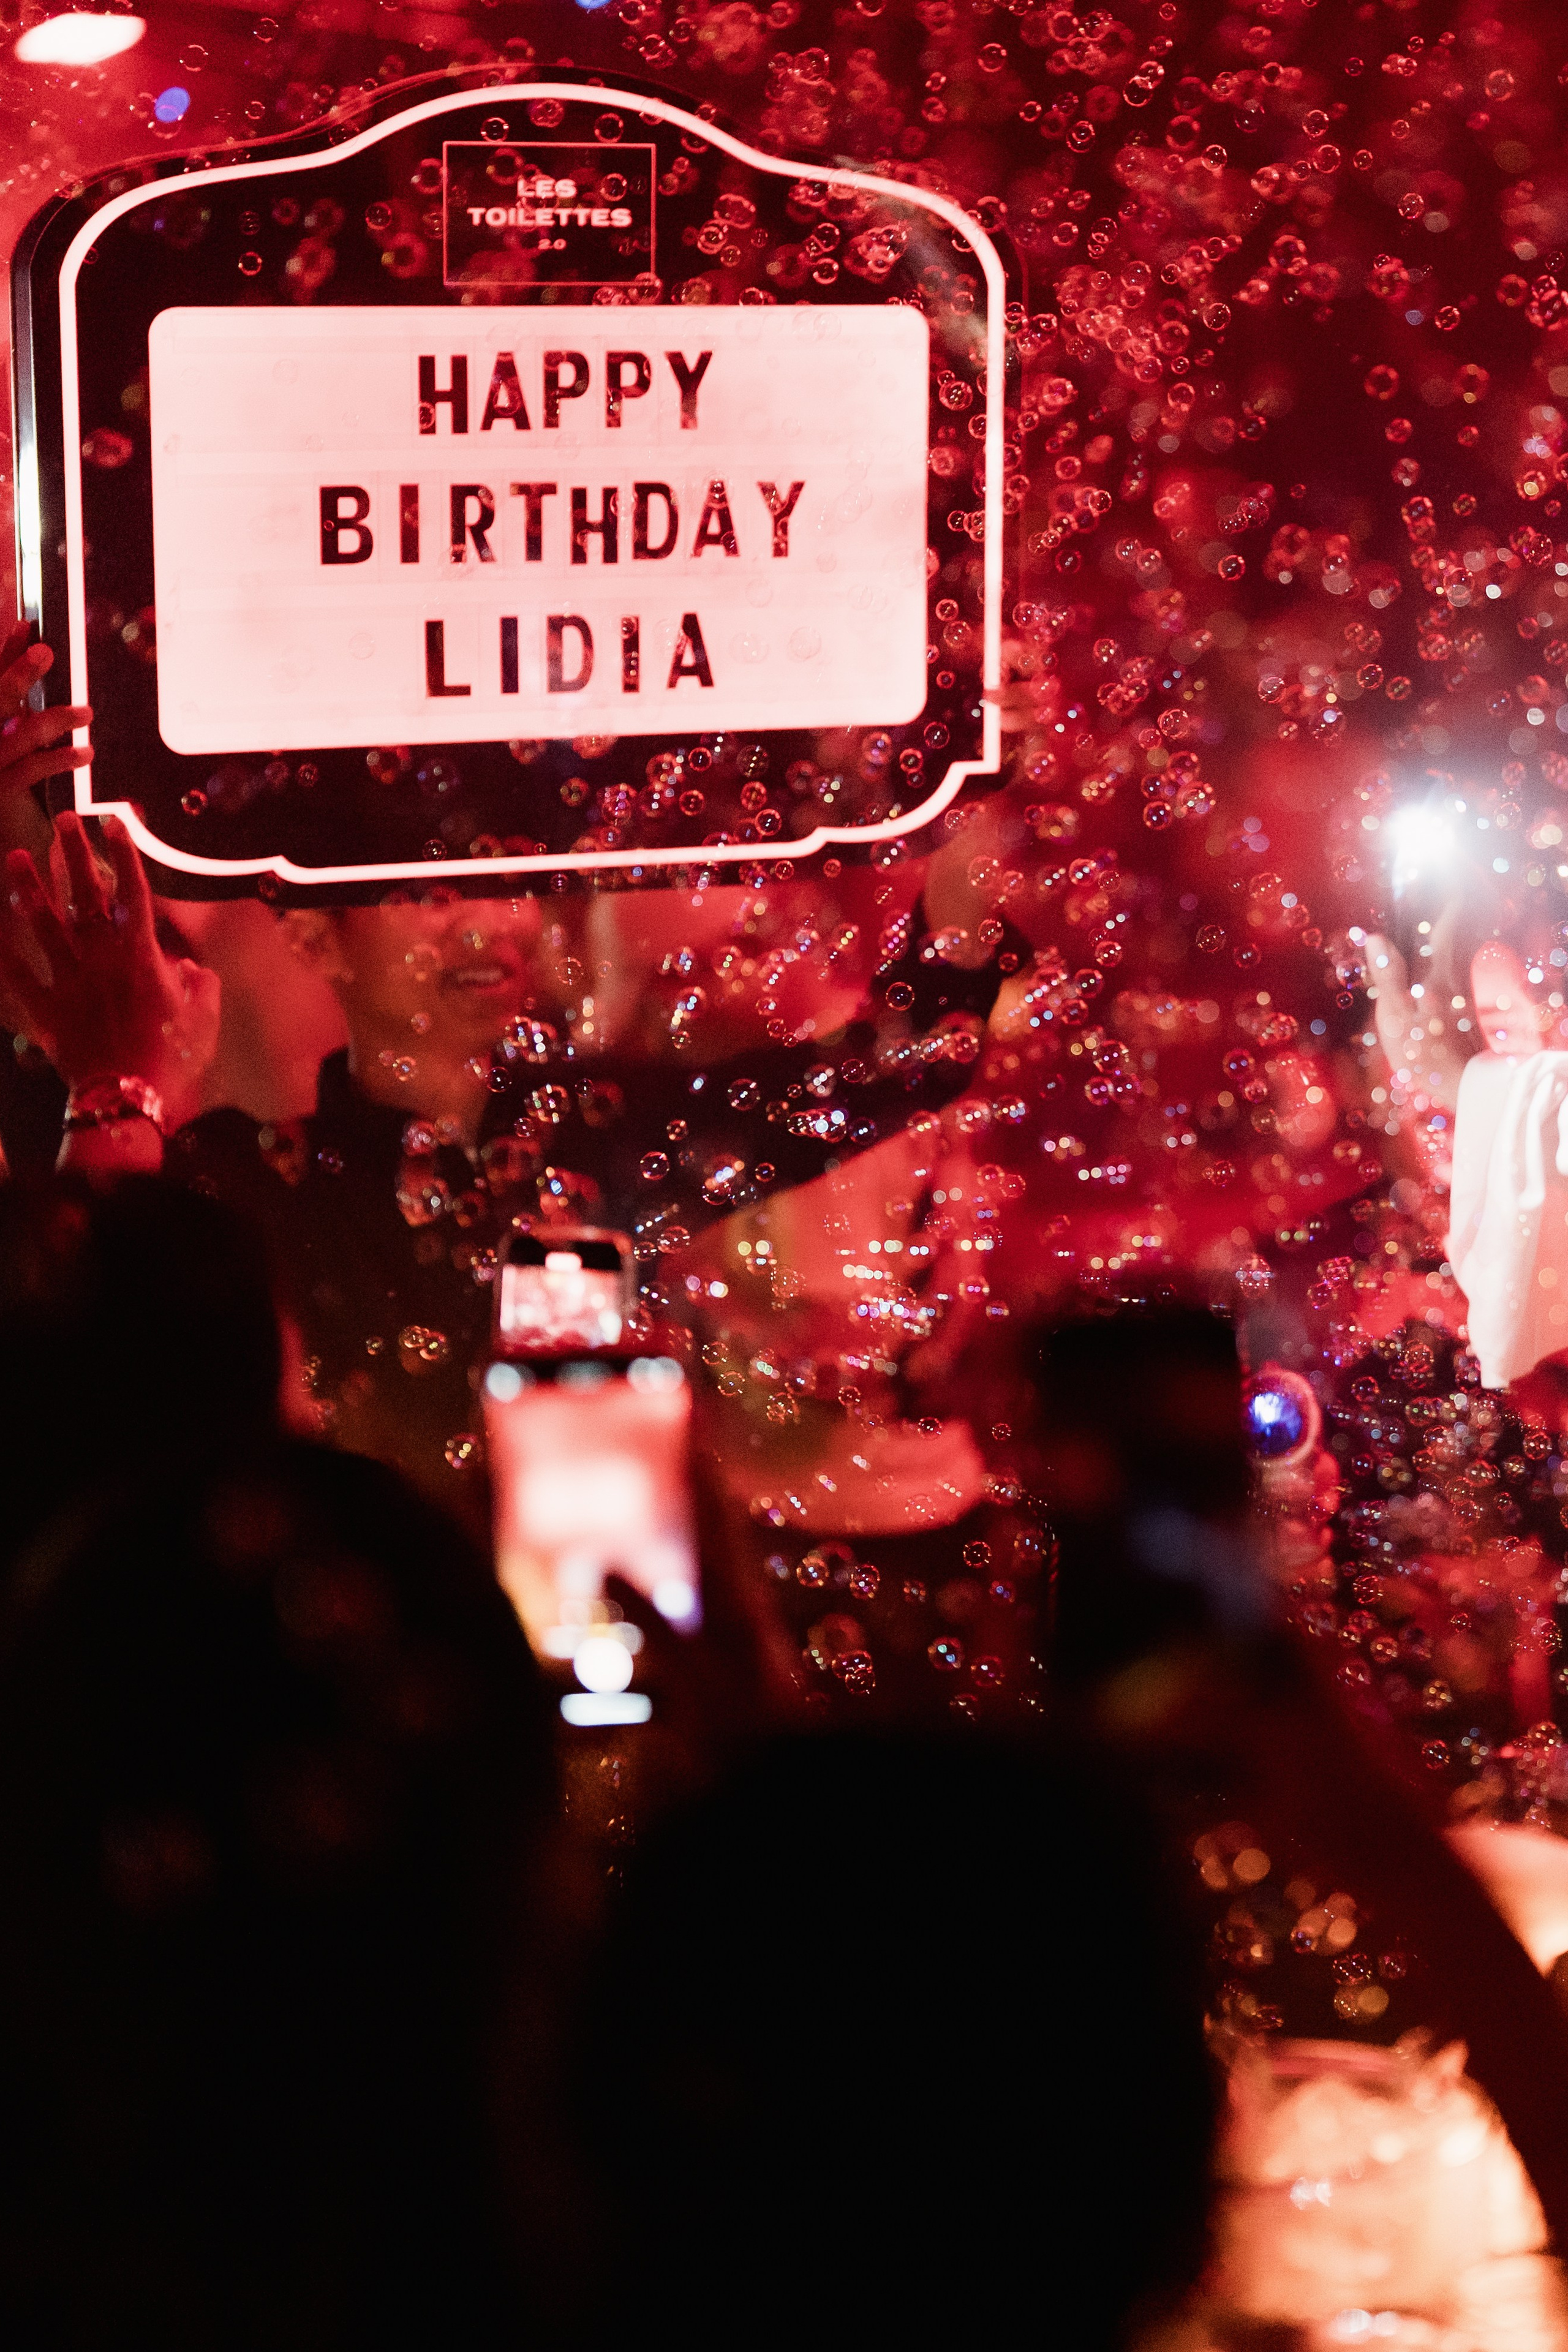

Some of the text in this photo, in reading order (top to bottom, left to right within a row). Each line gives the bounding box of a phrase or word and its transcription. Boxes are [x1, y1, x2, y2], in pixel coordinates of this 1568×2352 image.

[467, 208, 633, 227] TOILETTES
[517, 178, 577, 198] LES
[418, 350, 714, 435] HAPPY
[319, 481, 806, 566] BIRTHDAY
[424, 612, 715, 698] LIDIA
